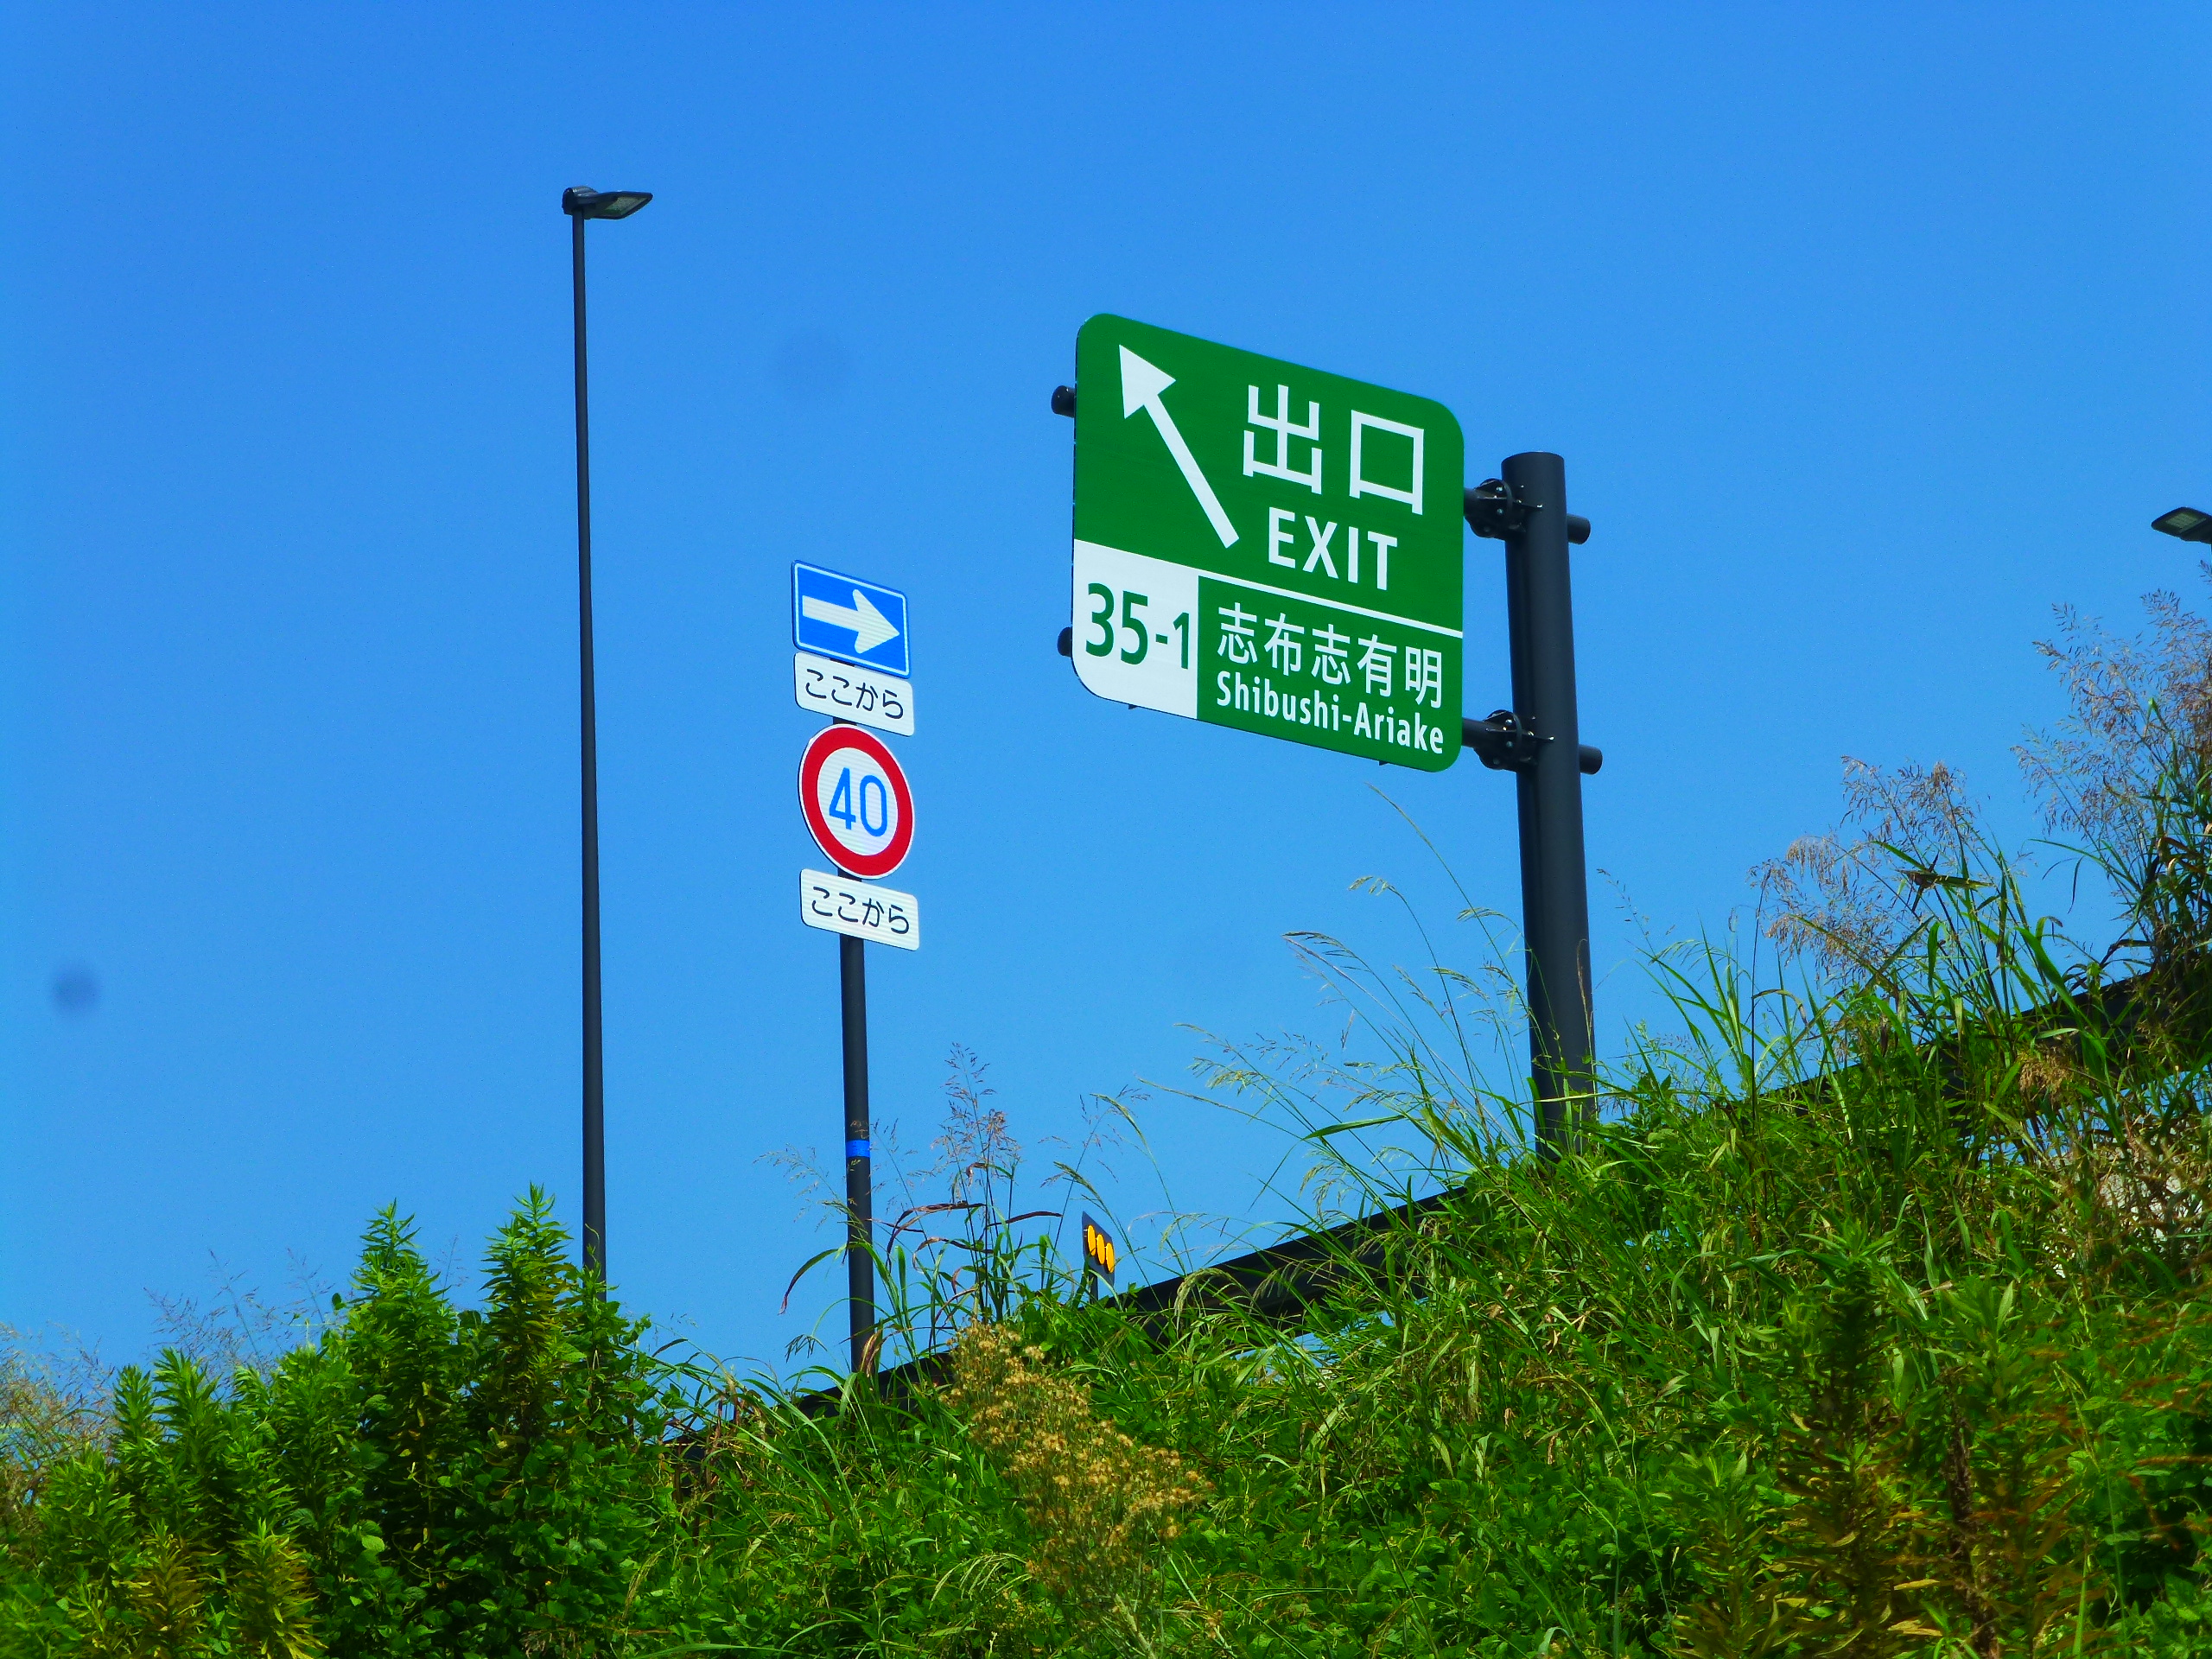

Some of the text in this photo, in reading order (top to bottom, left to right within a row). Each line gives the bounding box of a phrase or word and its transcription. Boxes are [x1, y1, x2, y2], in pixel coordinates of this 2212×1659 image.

[1243, 385, 1424, 515] 出口
[1268, 506, 1398, 590] EXIT
[1085, 582, 1190, 670] 35-1
[1217, 602, 1442, 709] 志布志有明
[804, 669, 904, 719] ここから
[1217, 671, 1444, 754] Shibushi-Ariake
[829, 767, 887, 837] 40
[811, 887, 909, 935] ここから
